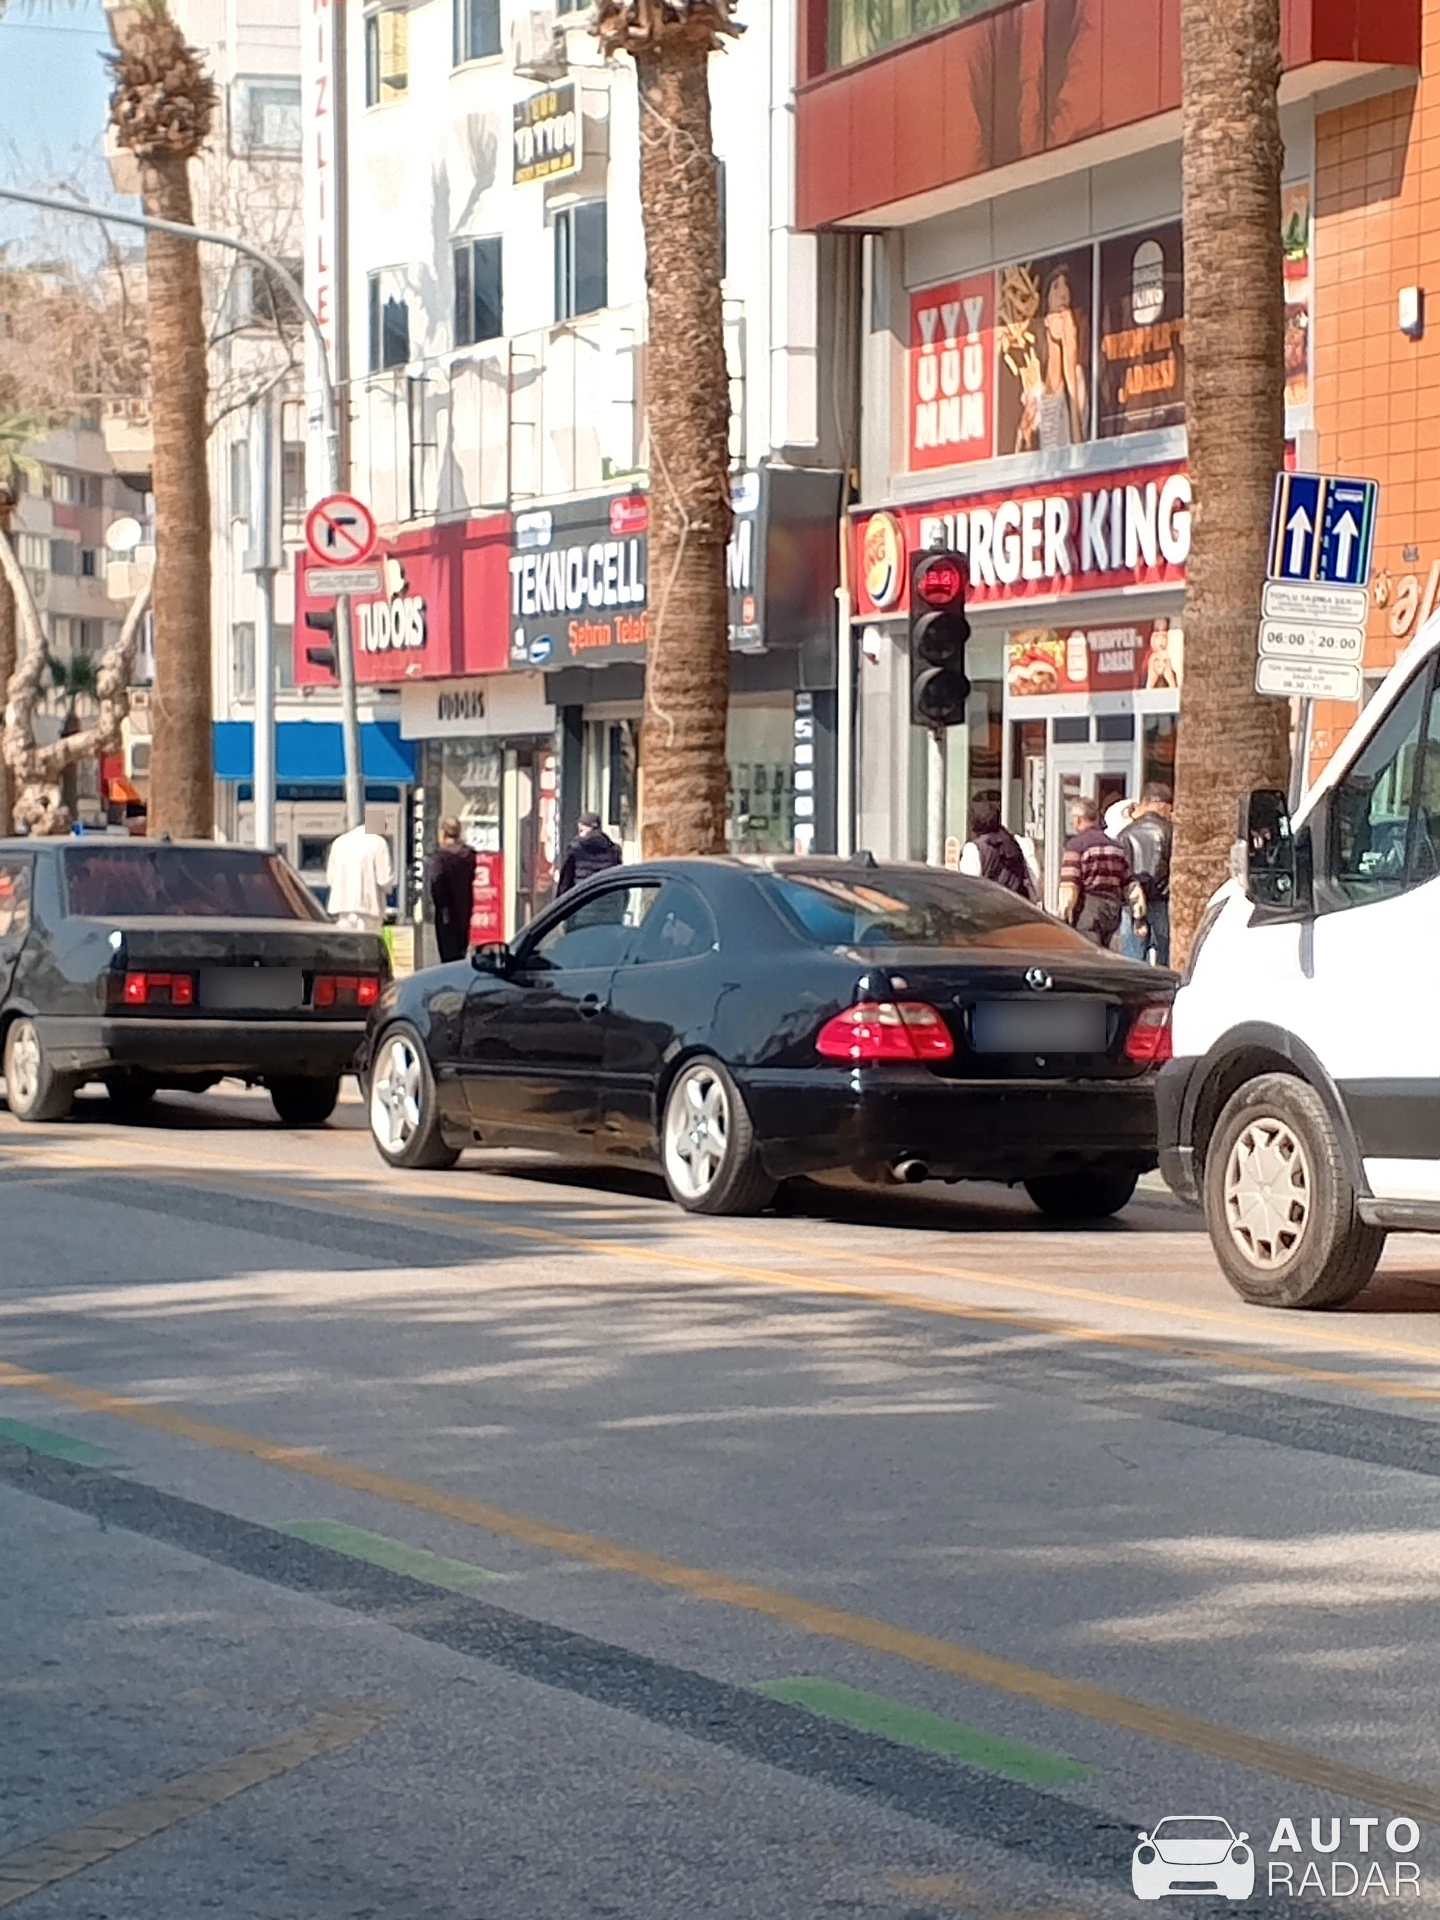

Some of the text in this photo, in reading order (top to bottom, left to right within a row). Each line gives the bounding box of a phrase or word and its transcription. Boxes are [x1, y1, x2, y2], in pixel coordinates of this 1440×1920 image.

[914, 391, 984, 449] MMM
[1081, 474, 1192, 571] KING
[355, 595, 425, 652] TUDORS
[1267, 631, 1305, 646] 06:00
[1318, 635, 1356, 650] 20:00
